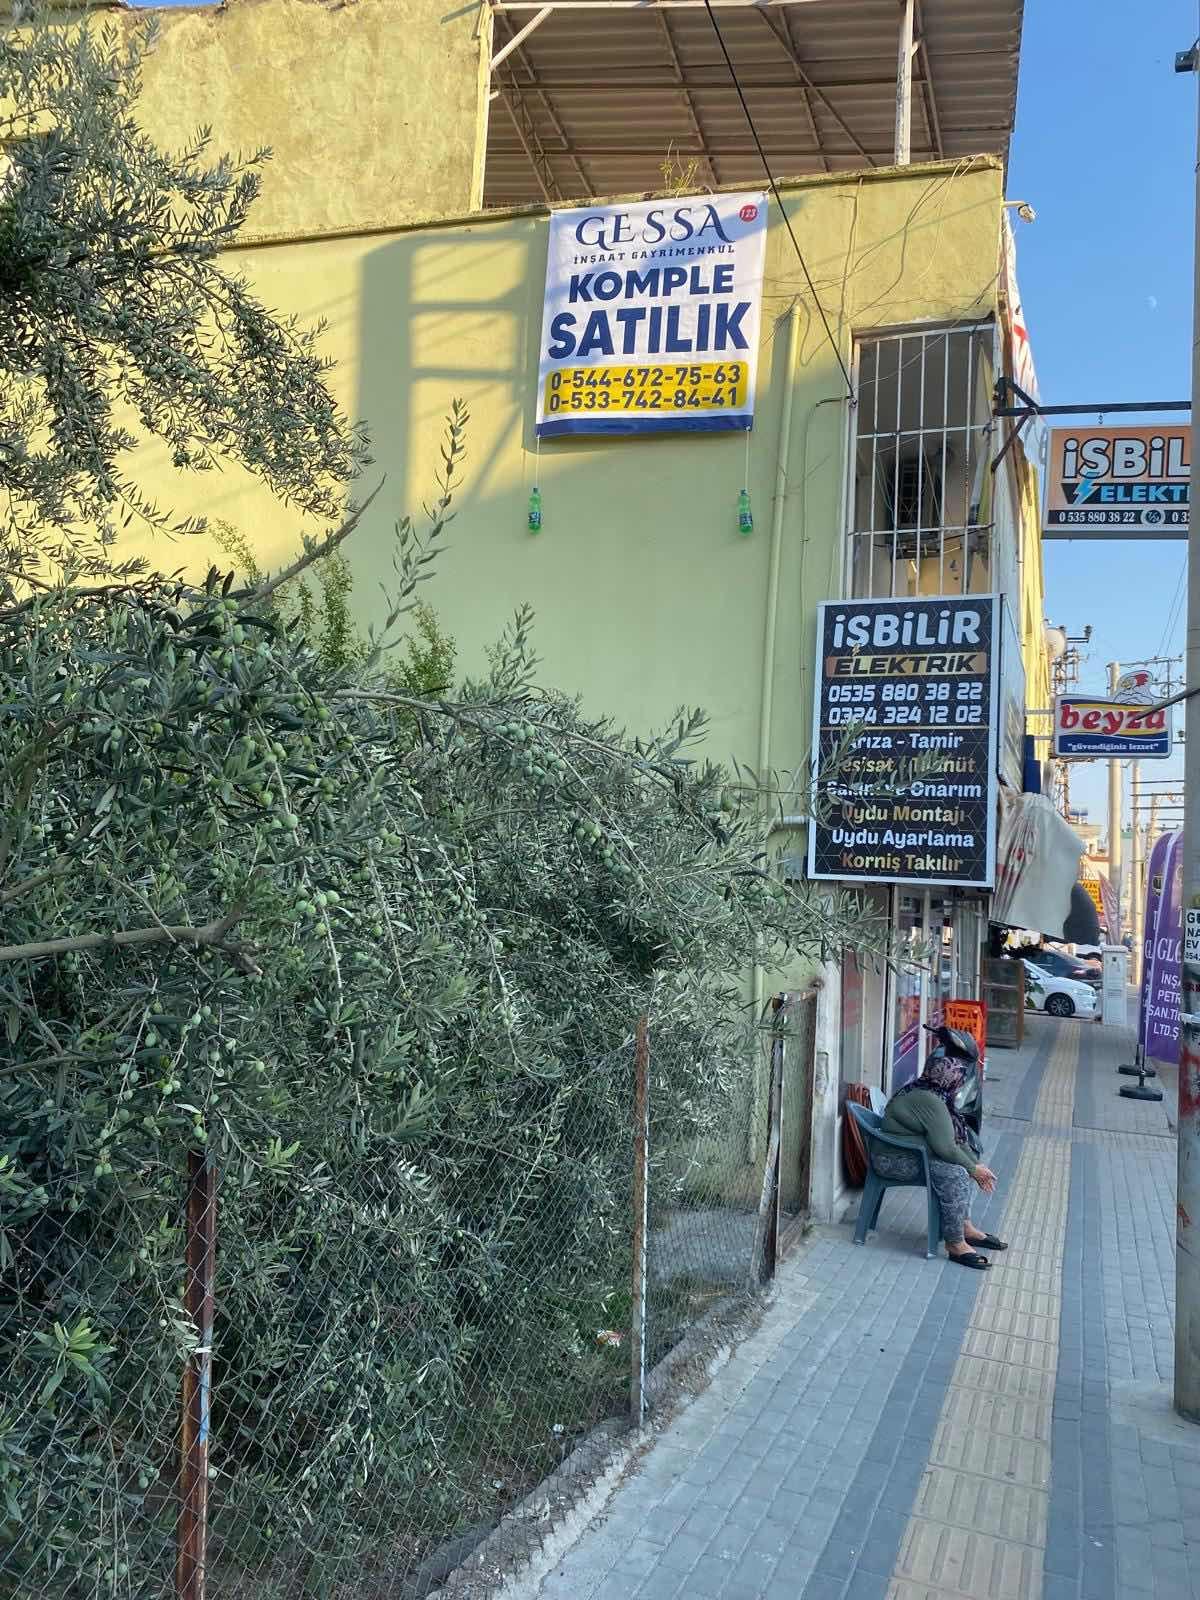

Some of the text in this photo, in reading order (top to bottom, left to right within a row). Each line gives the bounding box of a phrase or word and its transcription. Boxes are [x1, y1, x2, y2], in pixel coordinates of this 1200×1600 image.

[575, 204, 736, 251] GESSA
[574, 245, 735, 265] İNŞAAT GAYRİMENKUL
[568, 264, 735, 303] KOMPLE
[548, 302, 752, 360] SATILIK
[551, 365, 741, 391] 0-544-672-75-63
[550, 387, 738, 412] 0-533-742-84-41
[1101, 485, 1190, 502] ELEKT
[1059, 511, 1135, 523] 0 535 880 38 22
[1181, 511, 1190, 522] 3
[829, 681, 983, 703] 0535 880 38 22
[828, 705, 982, 724] 0324 324 12 02
[849, 734, 892, 749] rıza
[909, 732, 964, 749] Tamir
[910, 780, 982, 798] Onarım
[893, 805, 965, 826] Montajı
[832, 828, 975, 849] Uydu Ayarlama
[841, 852, 963, 872] Korniş Takılır
[1161, 970, 1181, 988] İNŞ
